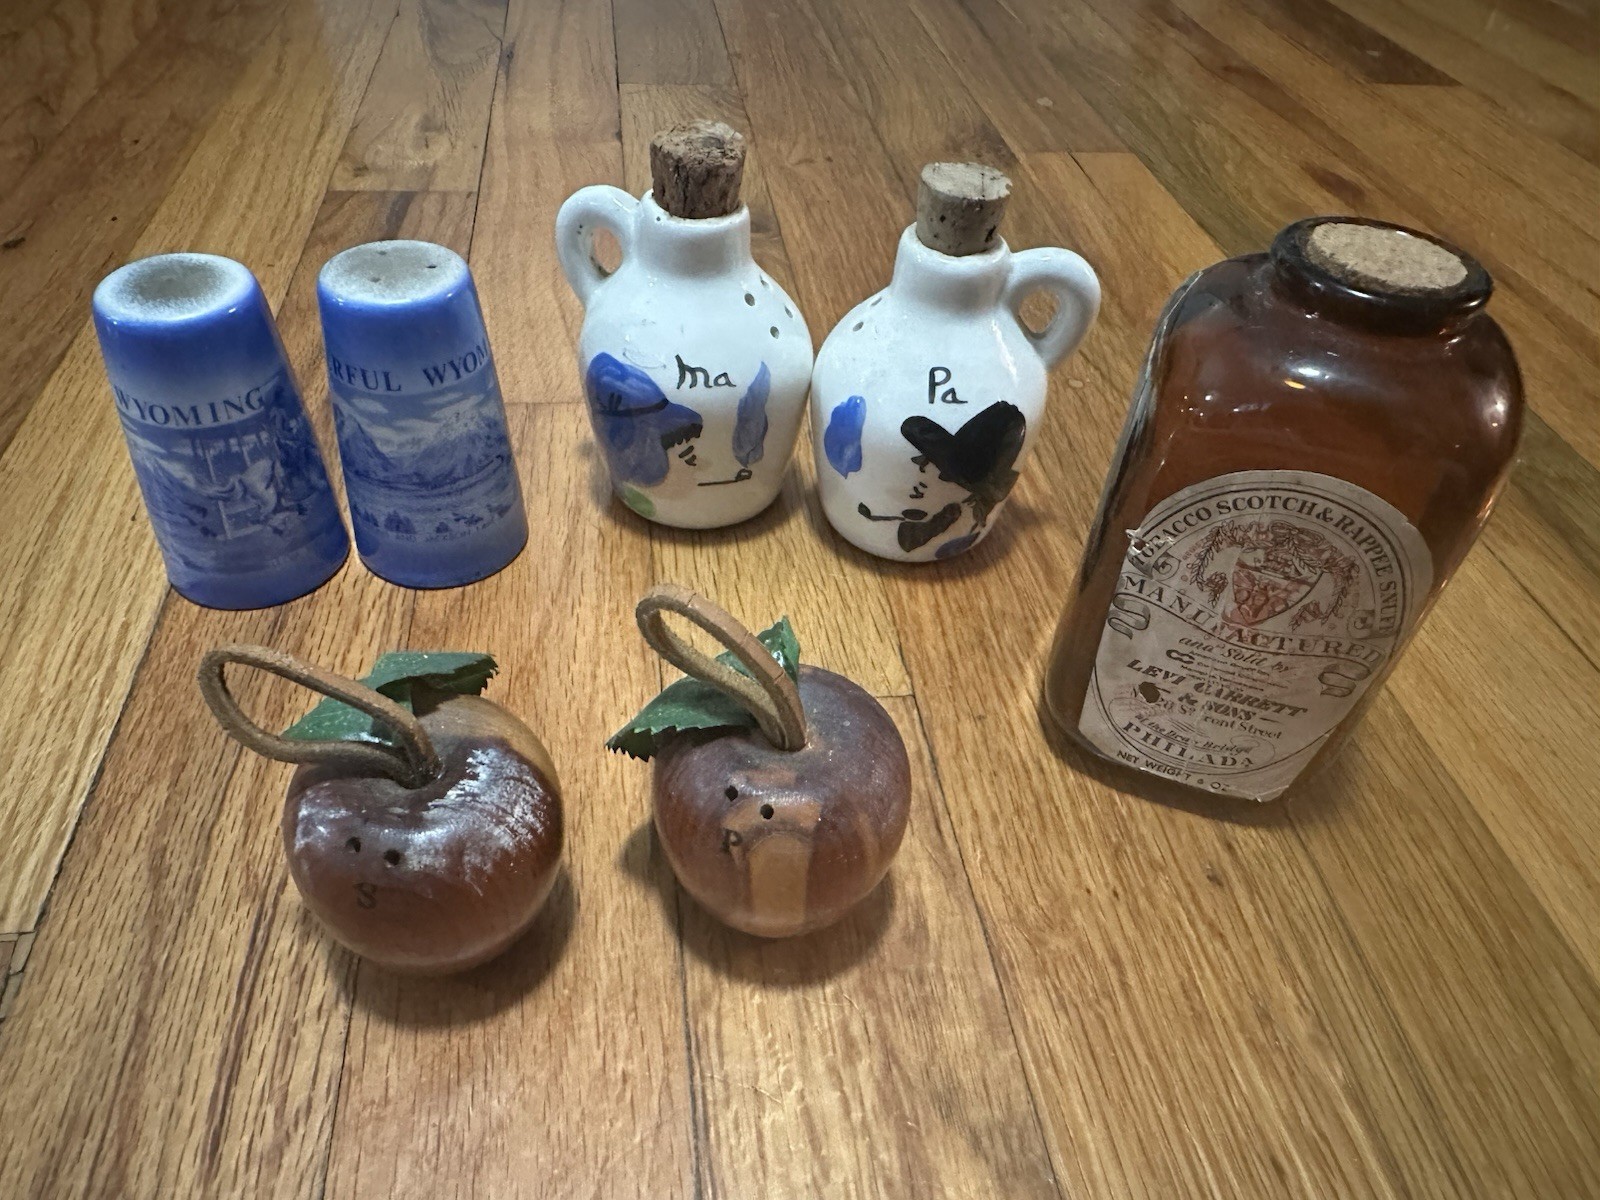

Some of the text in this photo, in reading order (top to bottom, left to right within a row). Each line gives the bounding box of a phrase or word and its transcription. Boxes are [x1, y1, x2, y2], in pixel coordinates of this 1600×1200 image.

[331, 355, 402, 392] RFUL
[928, 366, 968, 404] Pa
[113, 384, 265, 426] WYOMING
[1130, 495, 1399, 632] TOBACCO SCOTCH & RAPPEE SNUFF
[1127, 659, 1187, 685] LEVI
[1193, 682, 1309, 716] GARRETT
[1178, 692, 1199, 706] &
[1203, 716, 1236, 730] ront
[1240, 721, 1282, 739] Street
[1116, 750, 1140, 764] NET
[1145, 758, 1192, 781] WEIGHT
[720, 827, 743, 855] P
[353, 881, 377, 910] S
